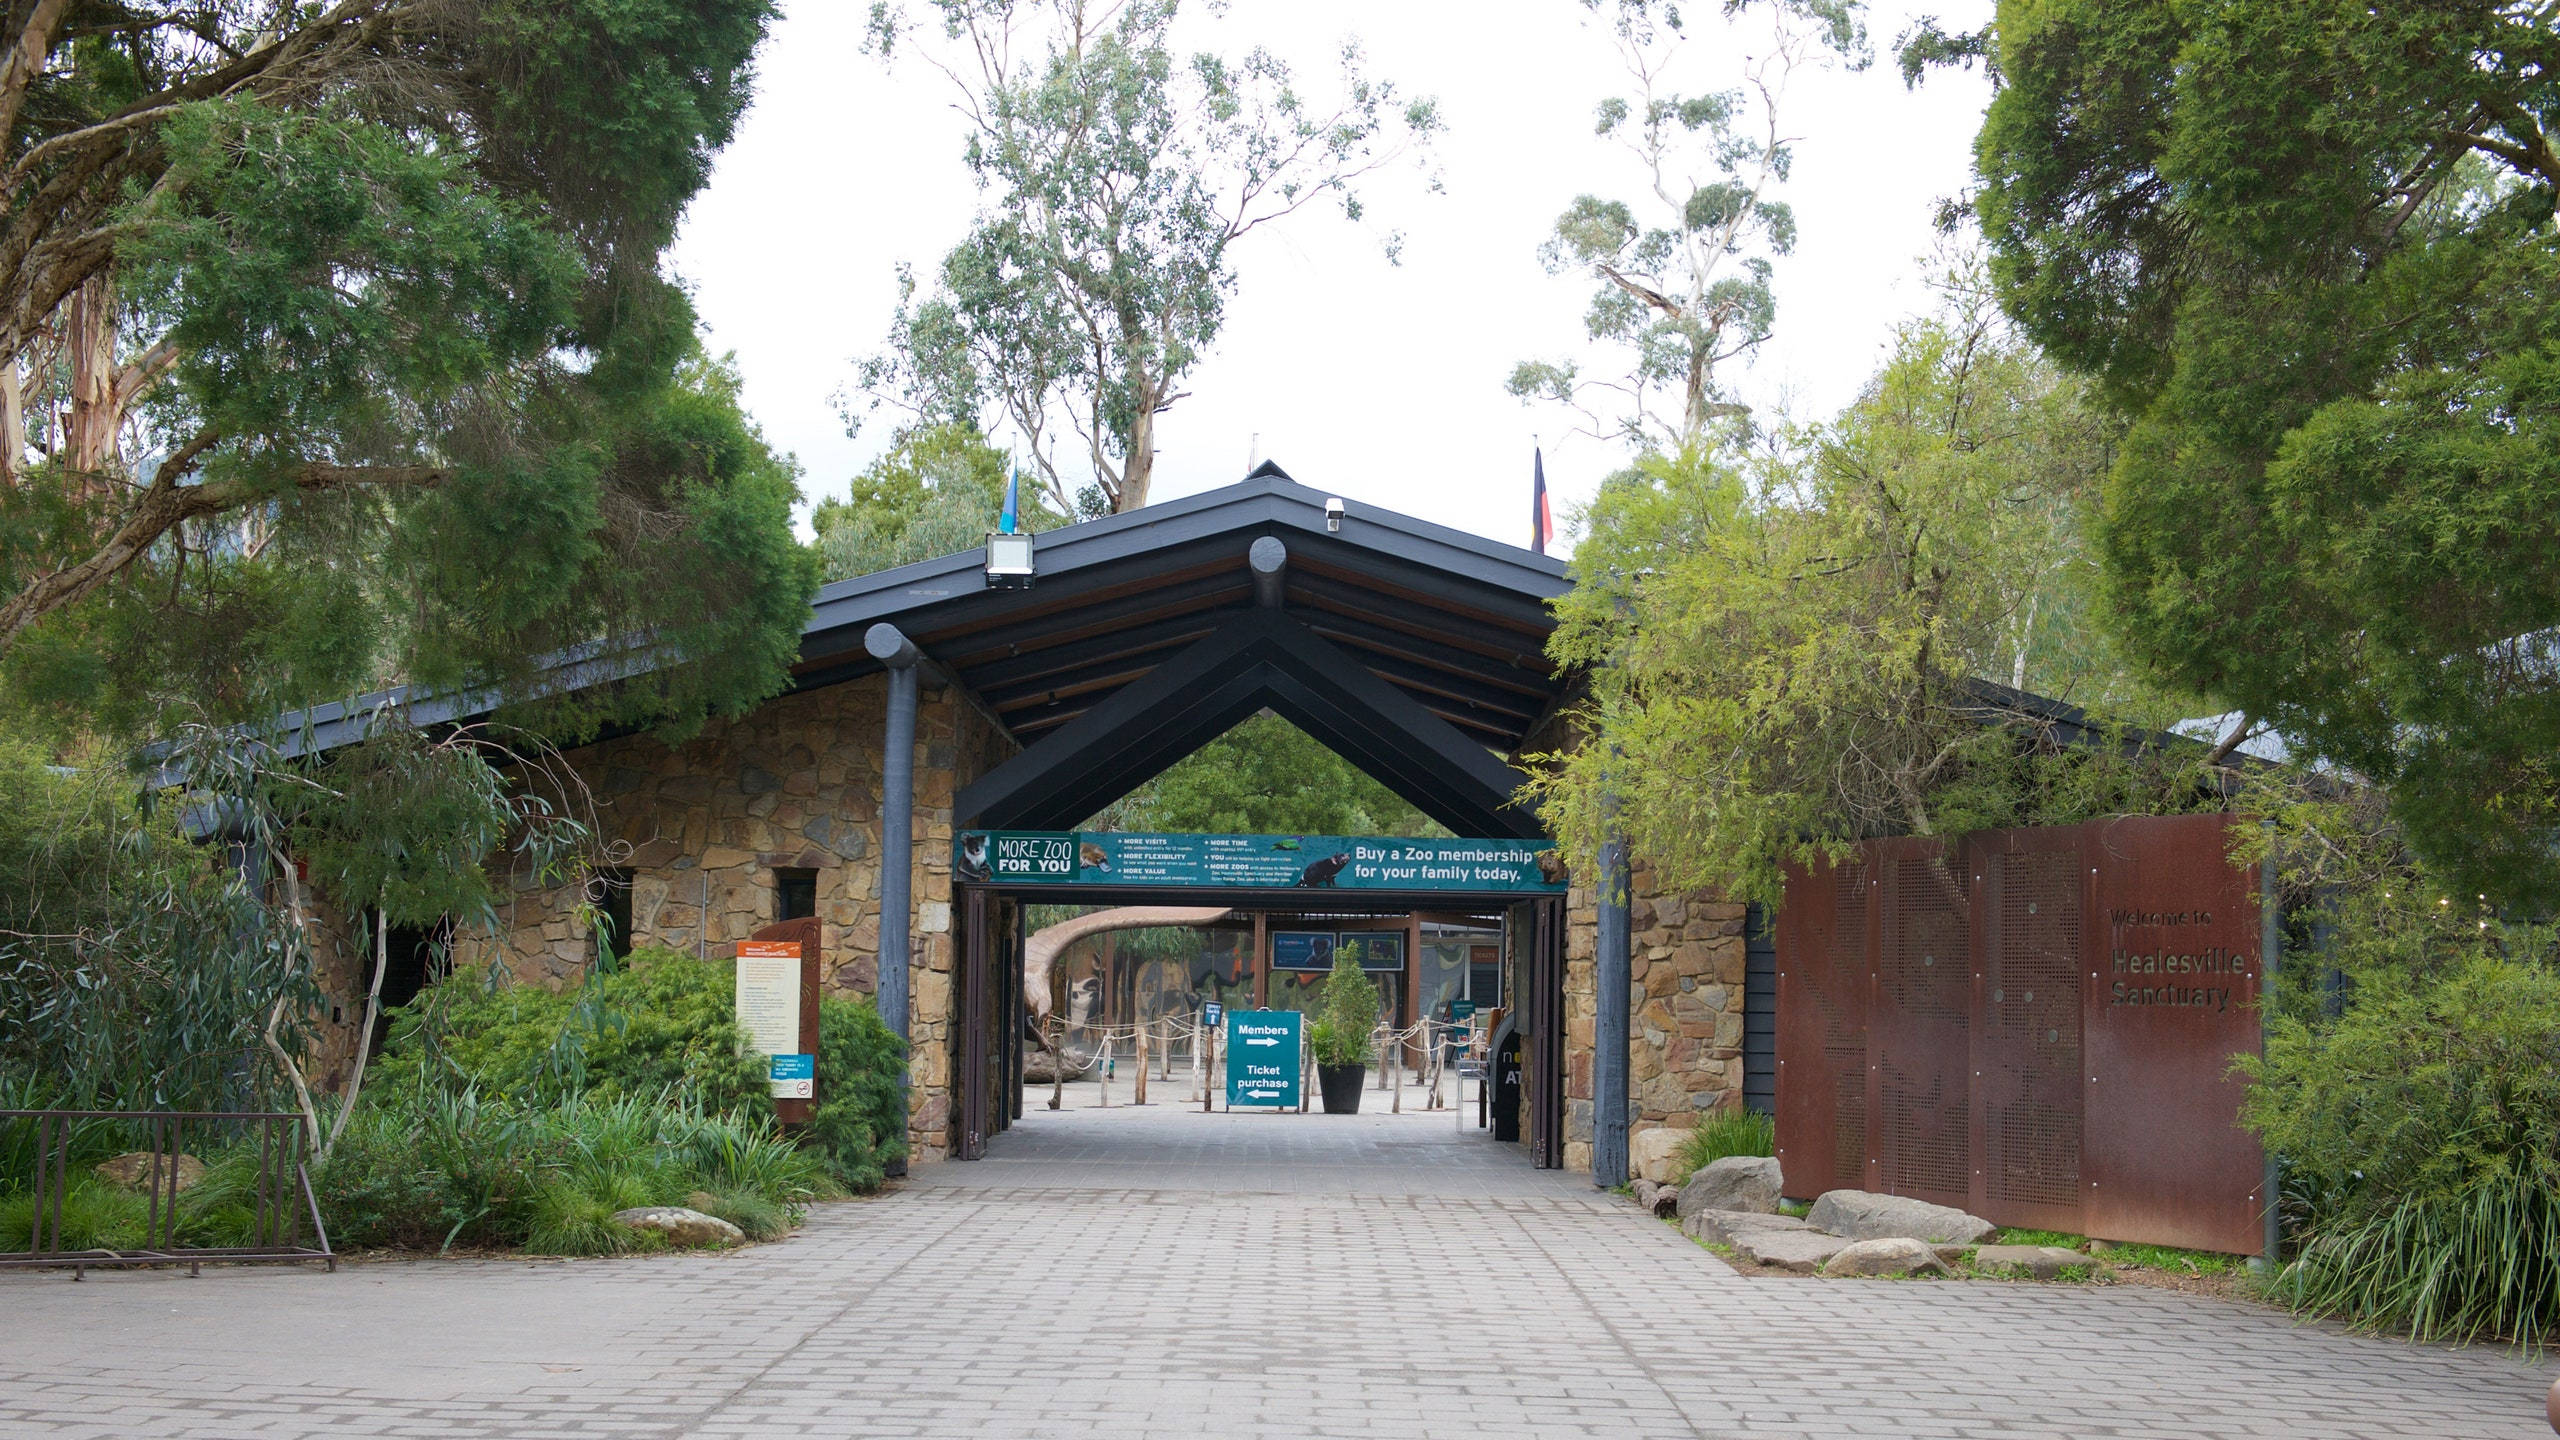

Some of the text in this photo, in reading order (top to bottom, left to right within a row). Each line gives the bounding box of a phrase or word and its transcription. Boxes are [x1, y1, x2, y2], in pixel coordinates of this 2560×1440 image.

[998, 840, 1072, 860] MORE ZOO
[1355, 846, 1533, 865] Buy a Zoo membership
[999, 859, 1071, 872] FOR YOU
[1355, 865, 1521, 883] for your family today.
[2110, 907, 2211, 928] Welcome to
[2112, 948, 2245, 974] Healesville
[2111, 980, 2231, 1013] Sanctuary
[1238, 1025, 1289, 1035] Members
[1246, 1065, 1280, 1075] Ticket
[1237, 1078, 1289, 1089] purchase
